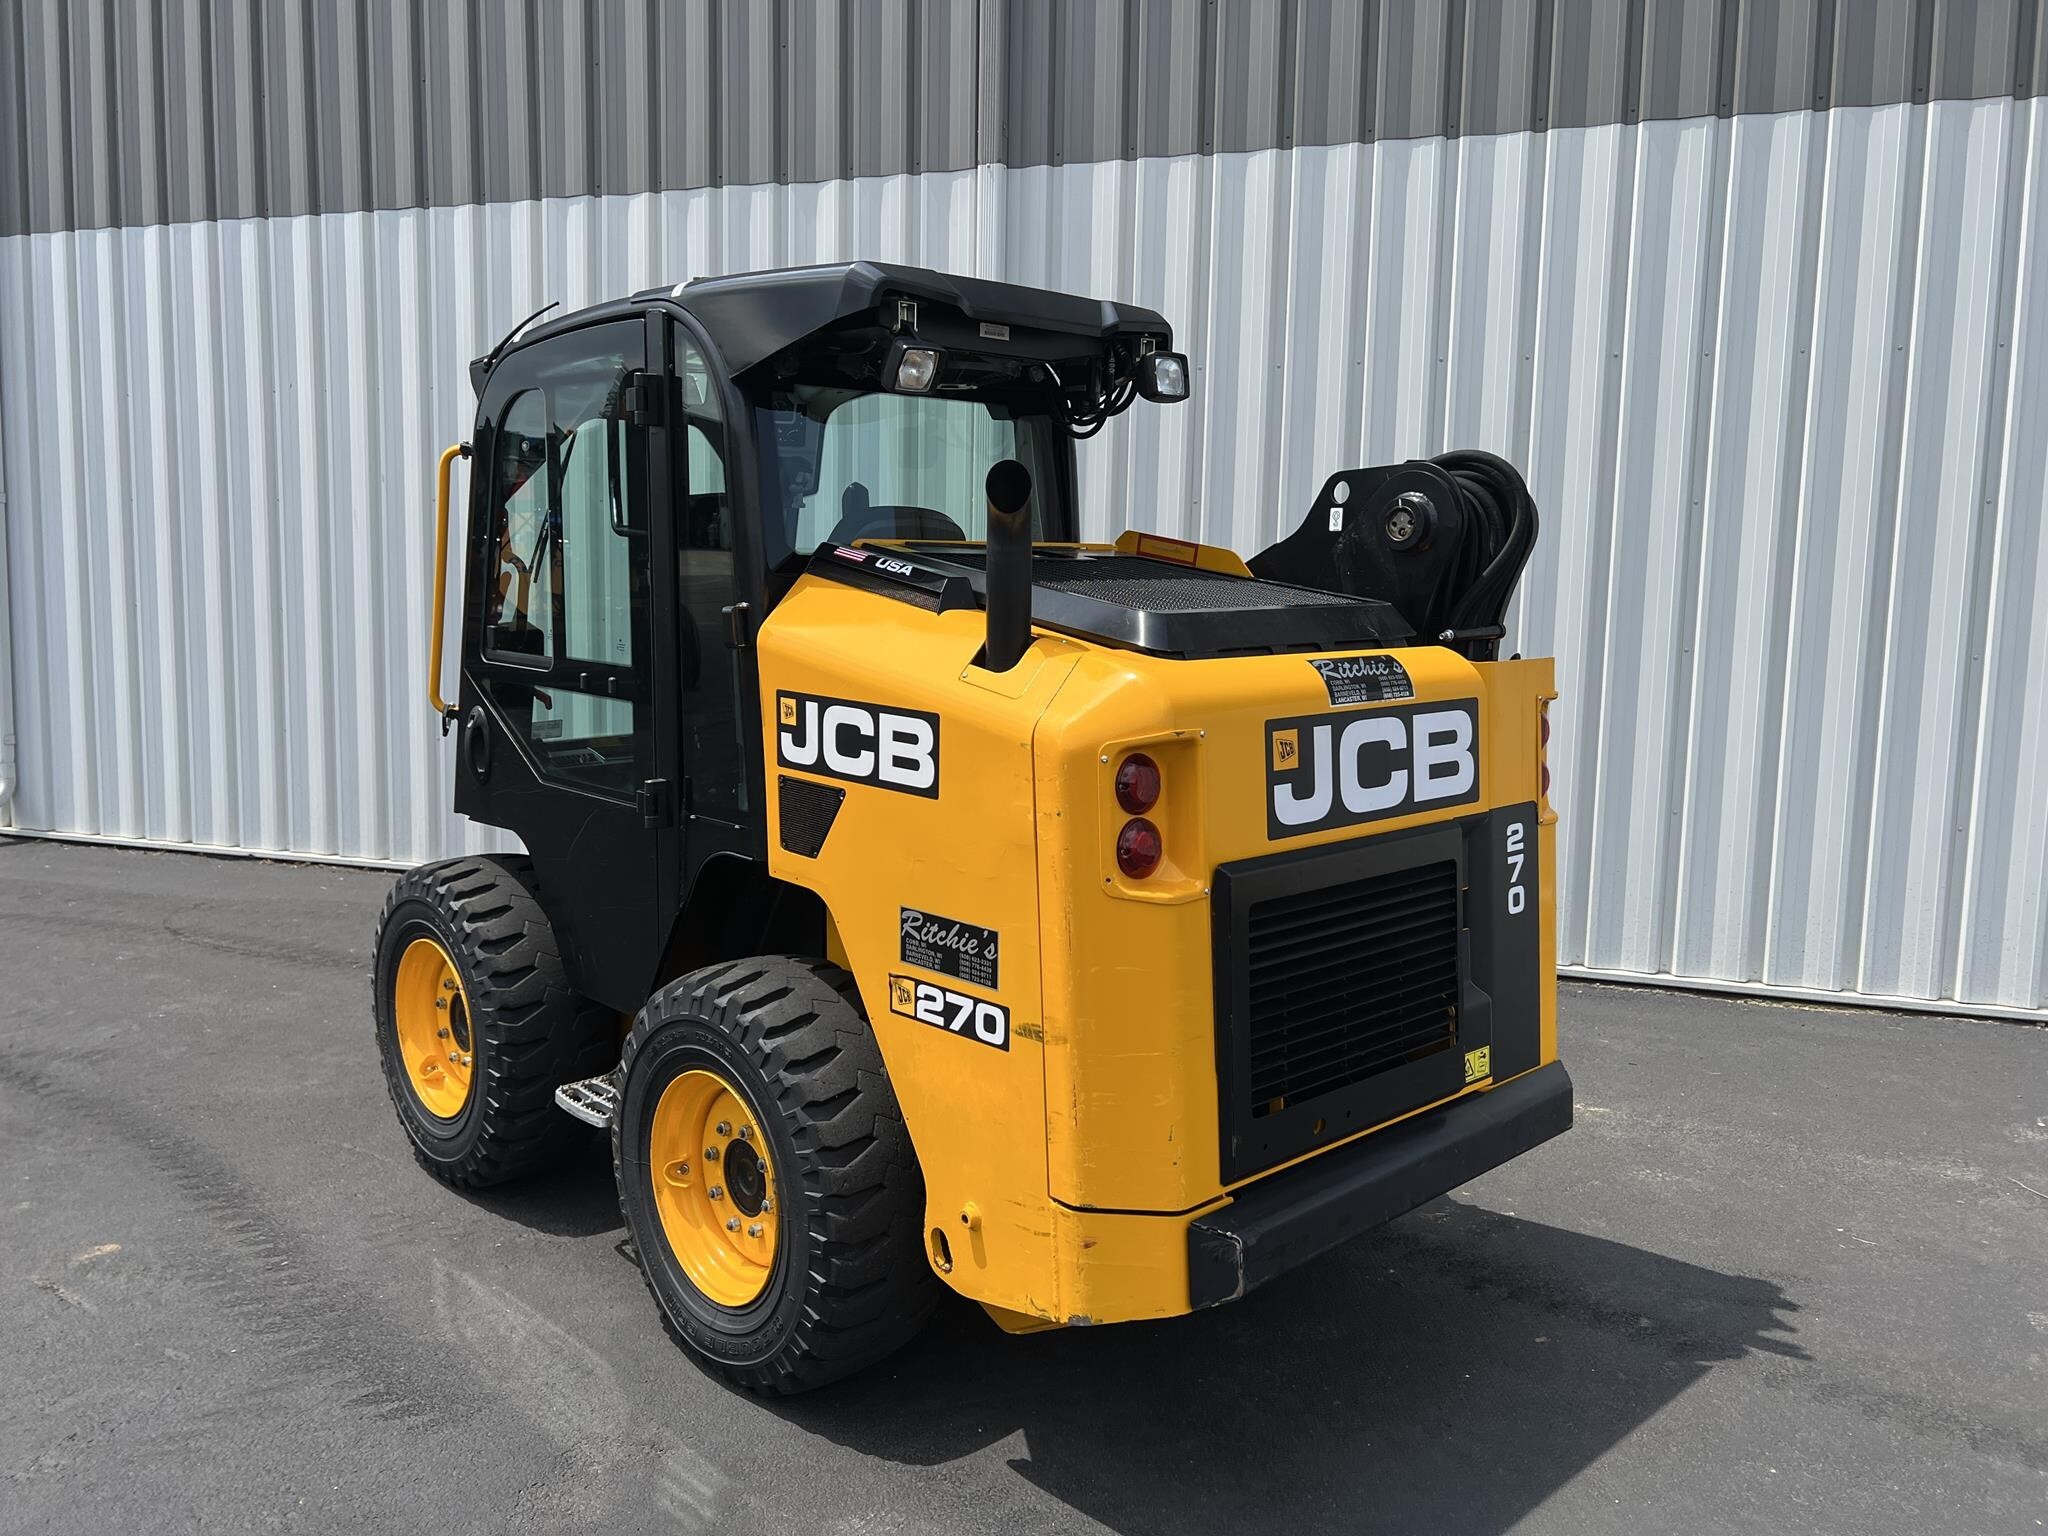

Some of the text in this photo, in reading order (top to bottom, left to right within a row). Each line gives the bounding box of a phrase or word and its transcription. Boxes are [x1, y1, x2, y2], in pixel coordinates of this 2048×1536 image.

[875, 558, 913, 576] USA
[1312, 656, 1404, 680] Ritchie's
[783, 703, 794, 718] JCB
[780, 701, 935, 789] JCB
[1279, 740, 1295, 759] JCB
[1274, 709, 1475, 826] JCB
[1506, 822, 1525, 915] 270
[901, 910, 997, 960] Ritchie's
[897, 986, 911, 1004] JCB
[917, 984, 1005, 1045] 270
